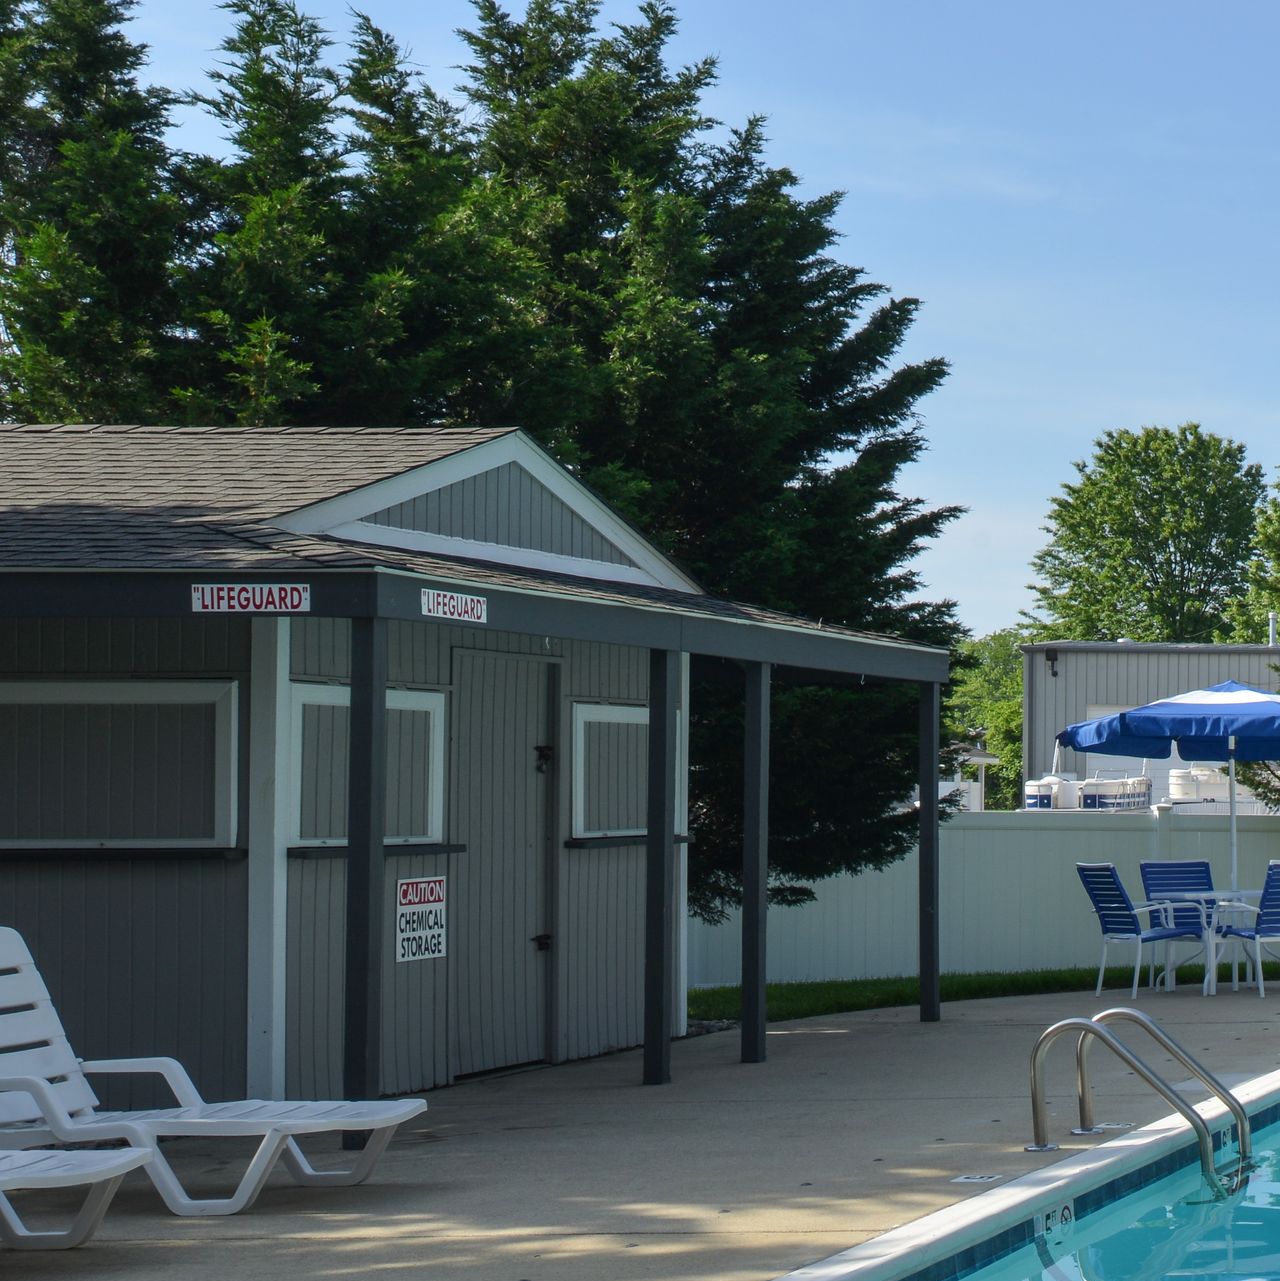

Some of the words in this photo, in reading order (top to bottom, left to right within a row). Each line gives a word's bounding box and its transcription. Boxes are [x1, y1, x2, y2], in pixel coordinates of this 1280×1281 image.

[193, 586, 309, 610] "LIFEGUARD"
[422, 590, 486, 621] "LIFEGUARD"
[400, 881, 444, 904] CAUTION
[399, 909, 444, 934] CHEMICAL
[401, 933, 442, 958] STORAGE
